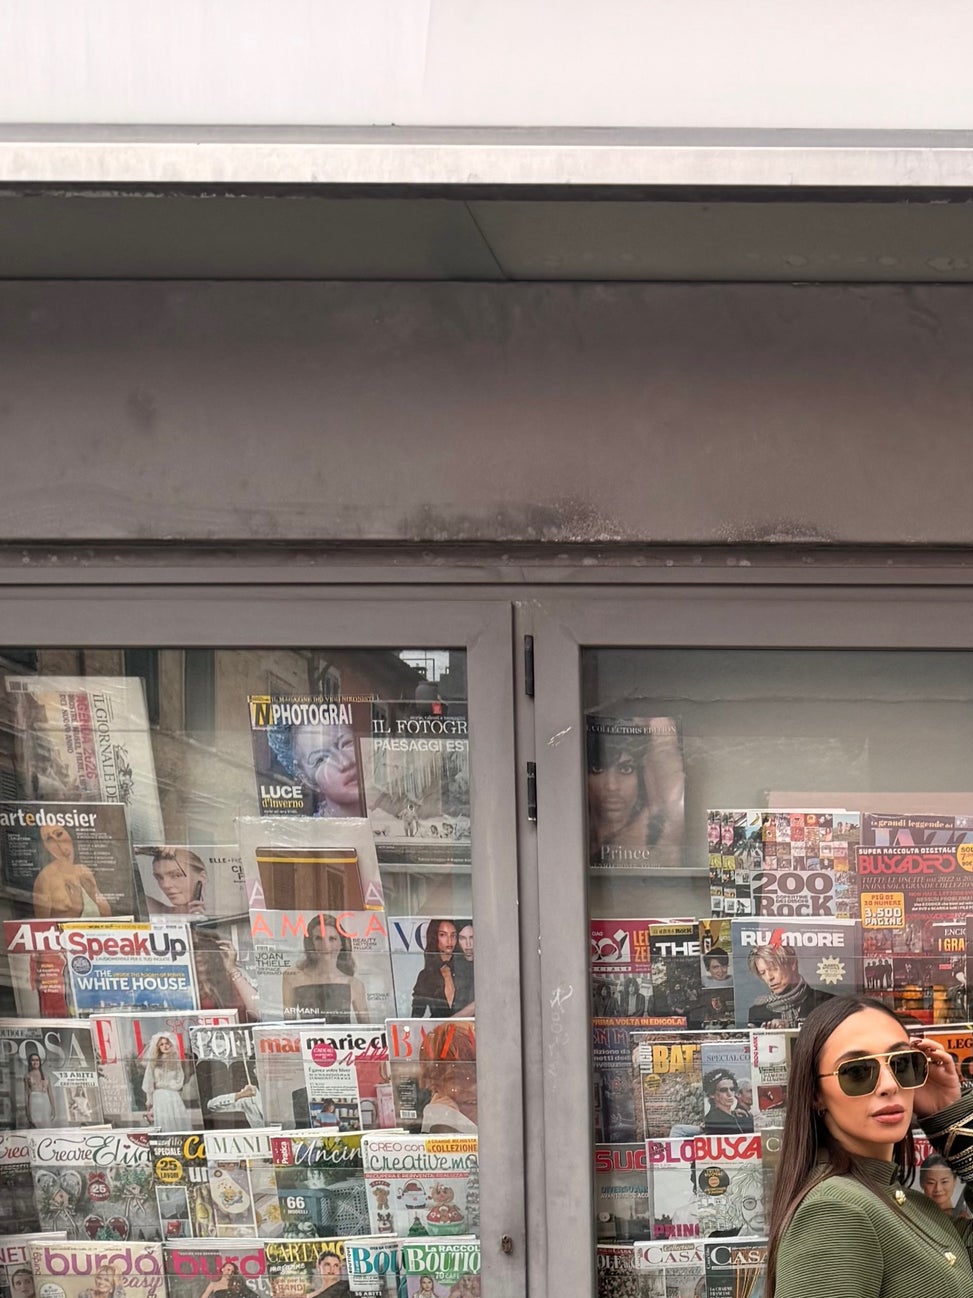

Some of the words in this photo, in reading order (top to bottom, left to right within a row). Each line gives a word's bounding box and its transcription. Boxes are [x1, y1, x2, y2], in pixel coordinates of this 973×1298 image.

[373, 720, 391, 735] IL
[592, 726, 640, 735] COLLECTORS
[375, 741, 442, 753] PAESAGGI
[261, 785, 303, 799] LUCE
[0, 808, 97, 828] artedossier
[878, 820, 905, 829] grandi
[908, 820, 943, 829] leggende
[601, 846, 650, 861] Prince
[859, 854, 956, 874] BUSCADERO
[752, 873, 833, 894] 200
[865, 907, 902, 918] 3.500
[251, 912, 387, 938] AMICA
[865, 917, 903, 926] PAGINE
[67, 932, 188, 962] SpeakUp
[256, 953, 283, 962] JOAN
[94, 970, 112, 978] THE
[78, 978, 131, 991] WHITE
[133, 978, 188, 991] HOUSE
[284, 1007, 319, 1016] ARMANI
[306, 1034, 365, 1051] marie
[154, 1147, 181, 1156] SPECIALE
[369, 1143, 402, 1156] CREO
[405, 1144, 425, 1156] con
[432, 1143, 477, 1153] COLLEZIONE
[160, 1160, 178, 1172] 25
[287, 1196, 305, 1209] 66
[45, 1249, 160, 1277] burda
